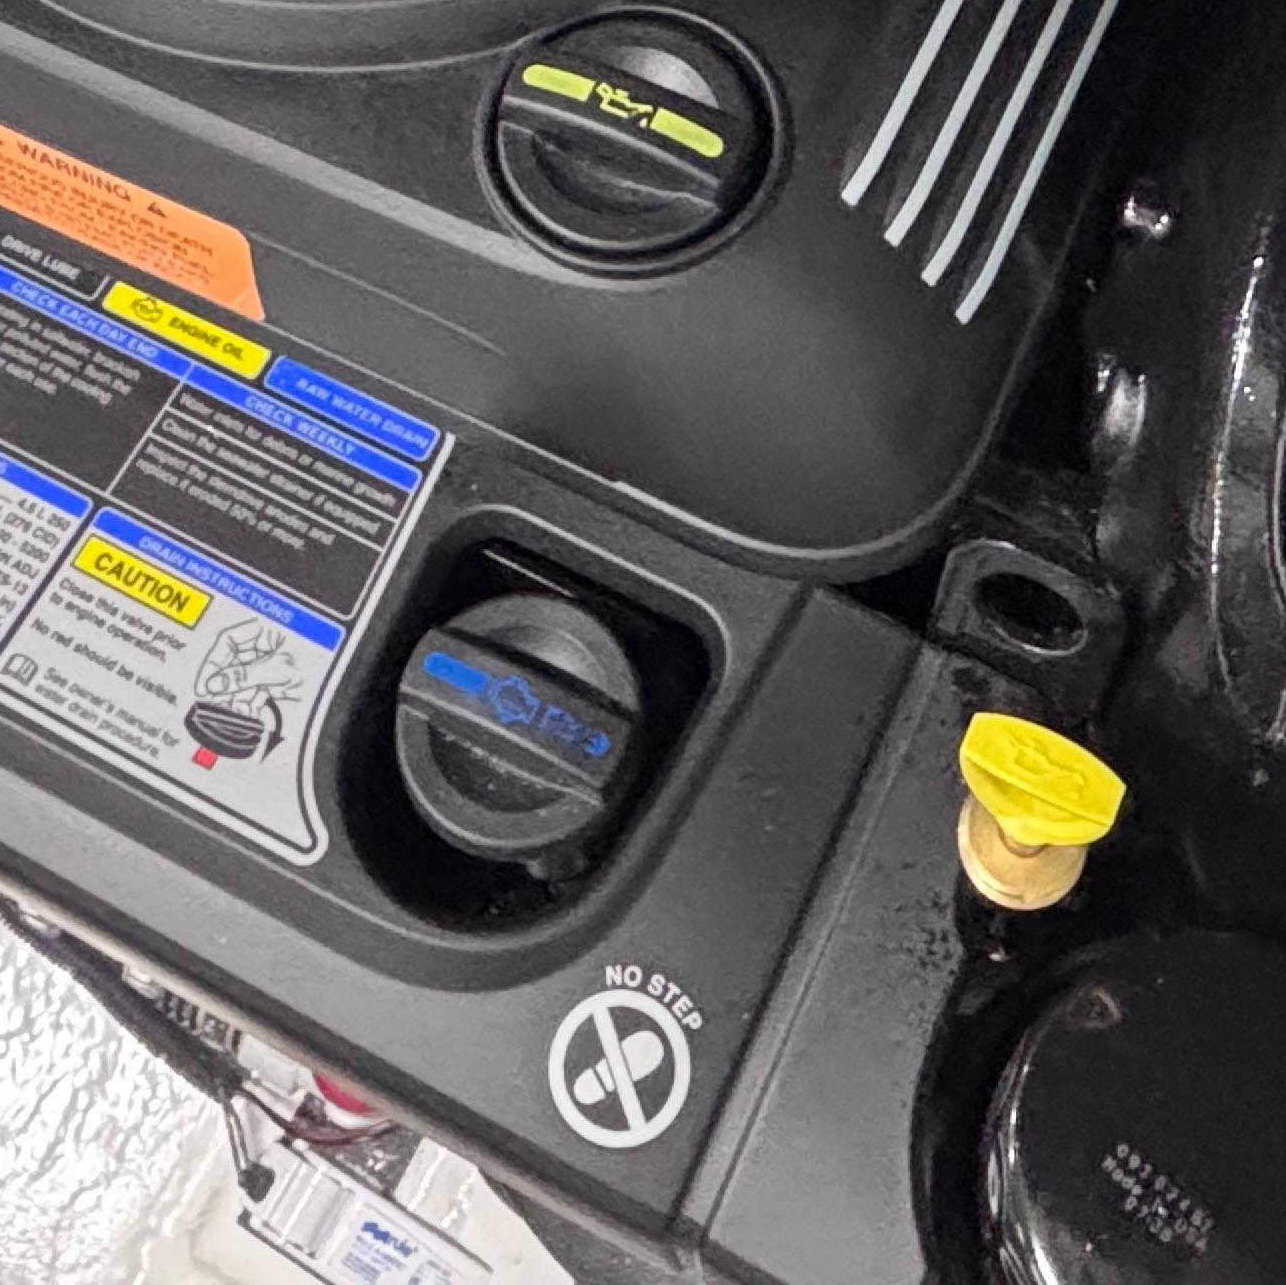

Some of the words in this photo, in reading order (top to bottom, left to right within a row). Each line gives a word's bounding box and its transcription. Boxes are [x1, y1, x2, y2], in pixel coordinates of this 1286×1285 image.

[11, 138, 135, 204] WARNING
[39, 252, 82, 281] LUBE
[8, 279, 59, 311] CHECK
[56, 302, 102, 332] EACH
[96, 321, 129, 345] DAY
[124, 335, 160, 361] END
[166, 314, 222, 349] ENGINE
[220, 339, 247, 361] OIL
[159, 417, 198, 444] Clean
[242, 393, 296, 428] CHECK
[293, 418, 357, 458] WEEKLY
[294, 376, 333, 402] RAW
[328, 392, 385, 428] WATER
[380, 418, 430, 450] DRAIN
[16, 496, 38, 515] 4.5
[35, 506, 48, 520] L
[46, 512, 72, 532] 250
[28, 524, 62, 551] CID)
[9, 556, 41, 581] ADJ
[91, 549, 192, 614] CAUTION
[137, 534, 188, 568] DRAIN
[183, 558, 295, 624] INSTRUCTIONS
[48, 590, 65, 606] to
[61, 599, 107, 632] engine
[104, 621, 170, 665] operation.
[56, 575, 96, 605] Close
[92, 594, 122, 618] this
[118, 608, 155, 636] valve
[150, 627, 187, 657] prior
[29, 616, 52, 636] No
[49, 627, 75, 648] red
[71, 639, 119, 672] should
[115, 662, 137, 682] be
[133, 672, 182, 707] visible.
[32, 681, 69, 707] water
[66, 698, 101, 725] drain
[96, 716, 164, 761] procedure.
[42, 665, 71, 689] See
[67, 679, 118, 715] owner's
[113, 704, 163, 740] manual
[159, 729, 182, 751] for
[605, 965, 642, 987] NO
[647, 974, 703, 1030] STEP
